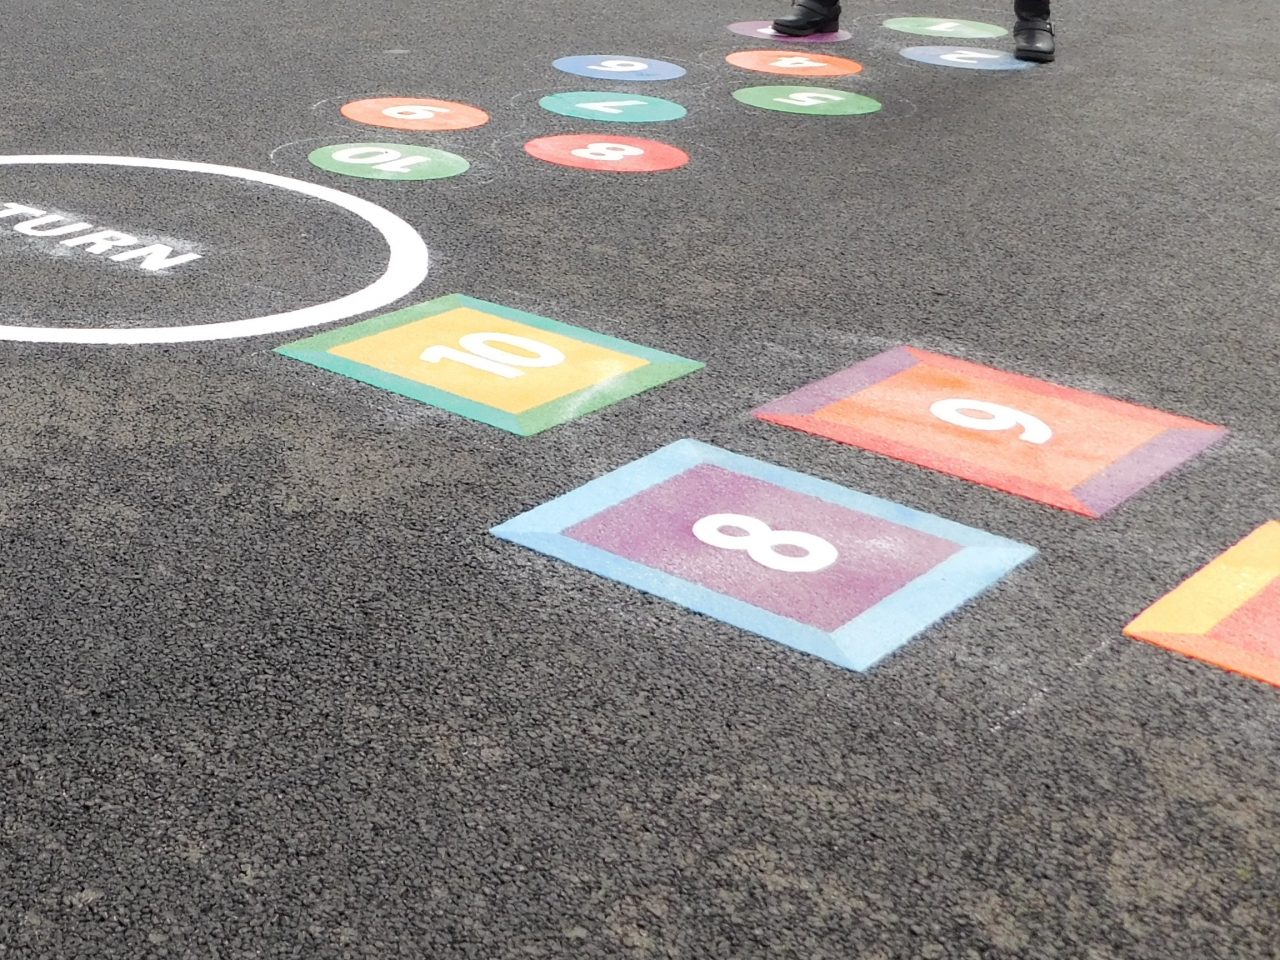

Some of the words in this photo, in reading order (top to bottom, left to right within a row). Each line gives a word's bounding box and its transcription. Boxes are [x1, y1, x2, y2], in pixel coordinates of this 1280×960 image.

[939, 50, 1000, 64] 2
[772, 92, 846, 106] 5
[331, 146, 432, 173] 10
[571, 143, 644, 161] 8
[419, 332, 566, 378] 10
[929, 397, 1054, 444] 9
[692, 513, 839, 572] 8
